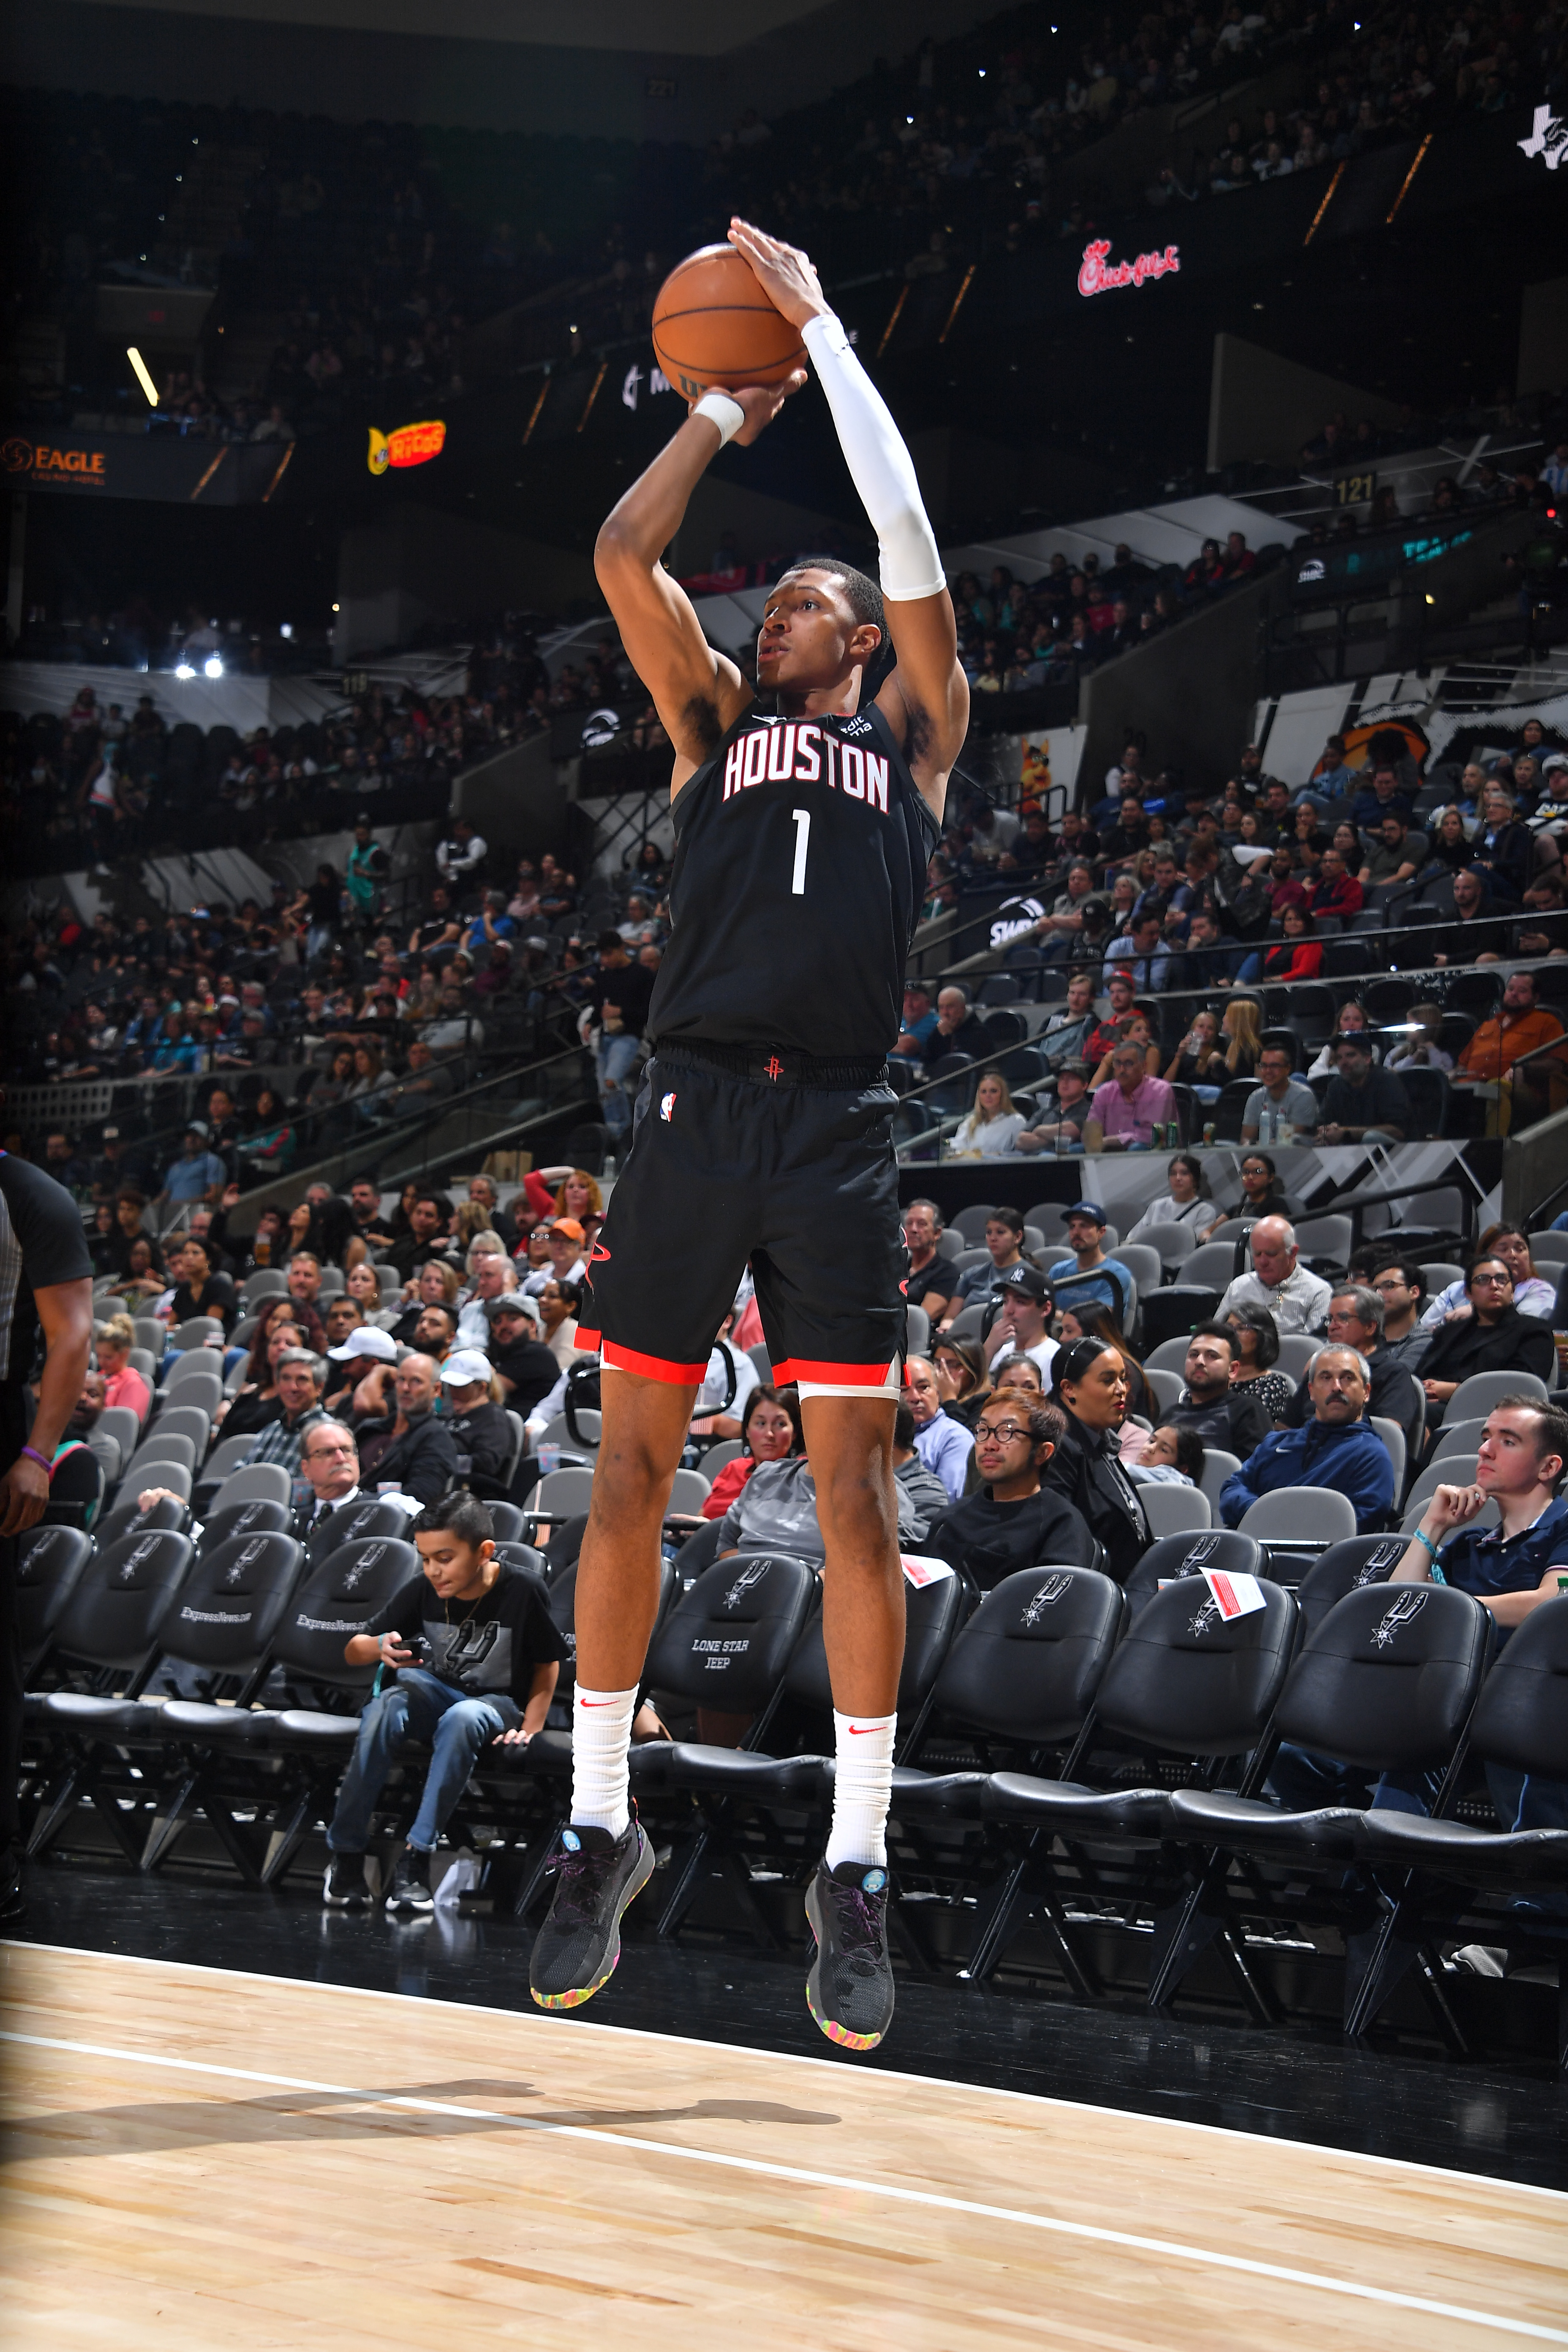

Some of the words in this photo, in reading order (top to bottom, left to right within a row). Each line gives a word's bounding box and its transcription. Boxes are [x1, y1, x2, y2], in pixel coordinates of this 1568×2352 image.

[35, 446, 105, 474] EAGLE
[1337, 474, 1372, 504] 121
[722, 724, 890, 815] HOUSTON
[792, 808, 811, 895] 1
[691, 1639, 722, 1652] LONE
[722, 1639, 750, 1652] STAR
[704, 1657, 731, 1670] JEEP
